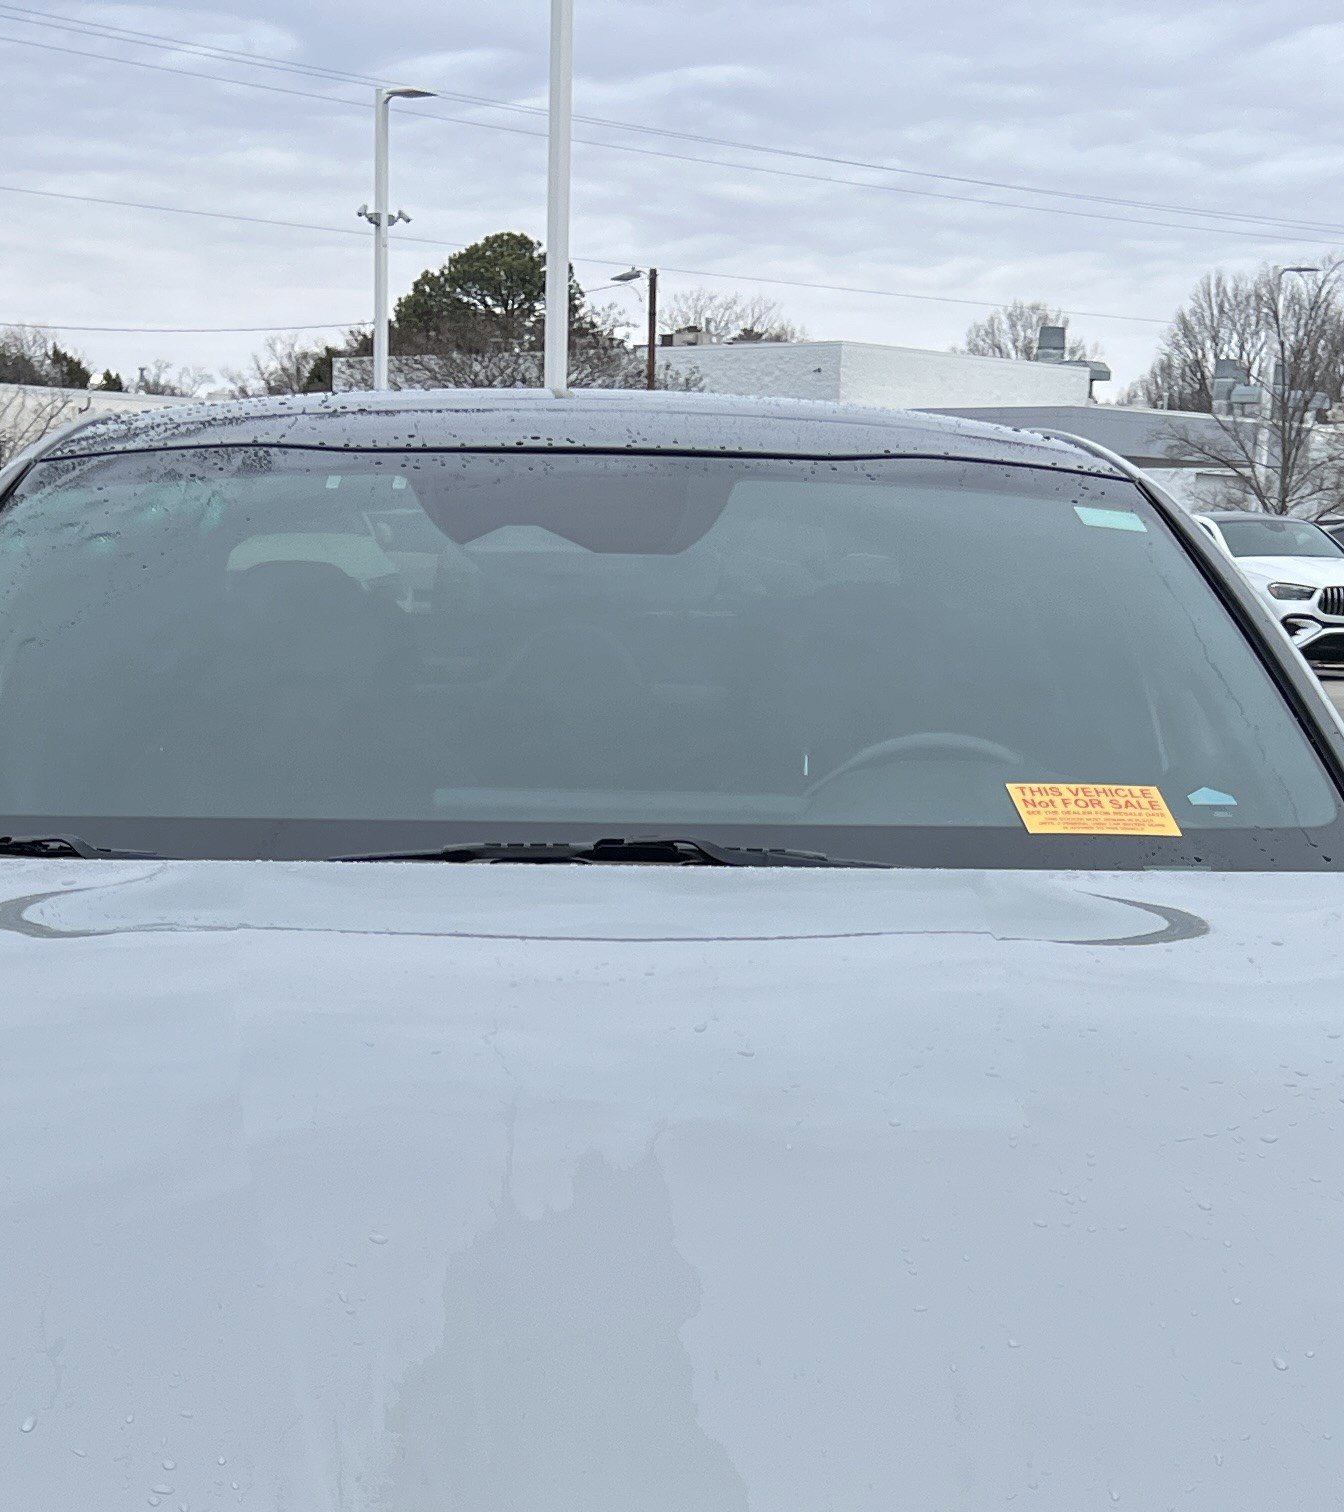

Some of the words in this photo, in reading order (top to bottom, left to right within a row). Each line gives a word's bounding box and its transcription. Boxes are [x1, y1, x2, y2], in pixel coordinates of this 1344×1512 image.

[1015, 786, 1063, 797] THIS
[1066, 787, 1154, 799] VEHICLE
[1022, 798, 1057, 809] Not
[1061, 798, 1104, 809] FOR
[1108, 799, 1162, 811] SALE
